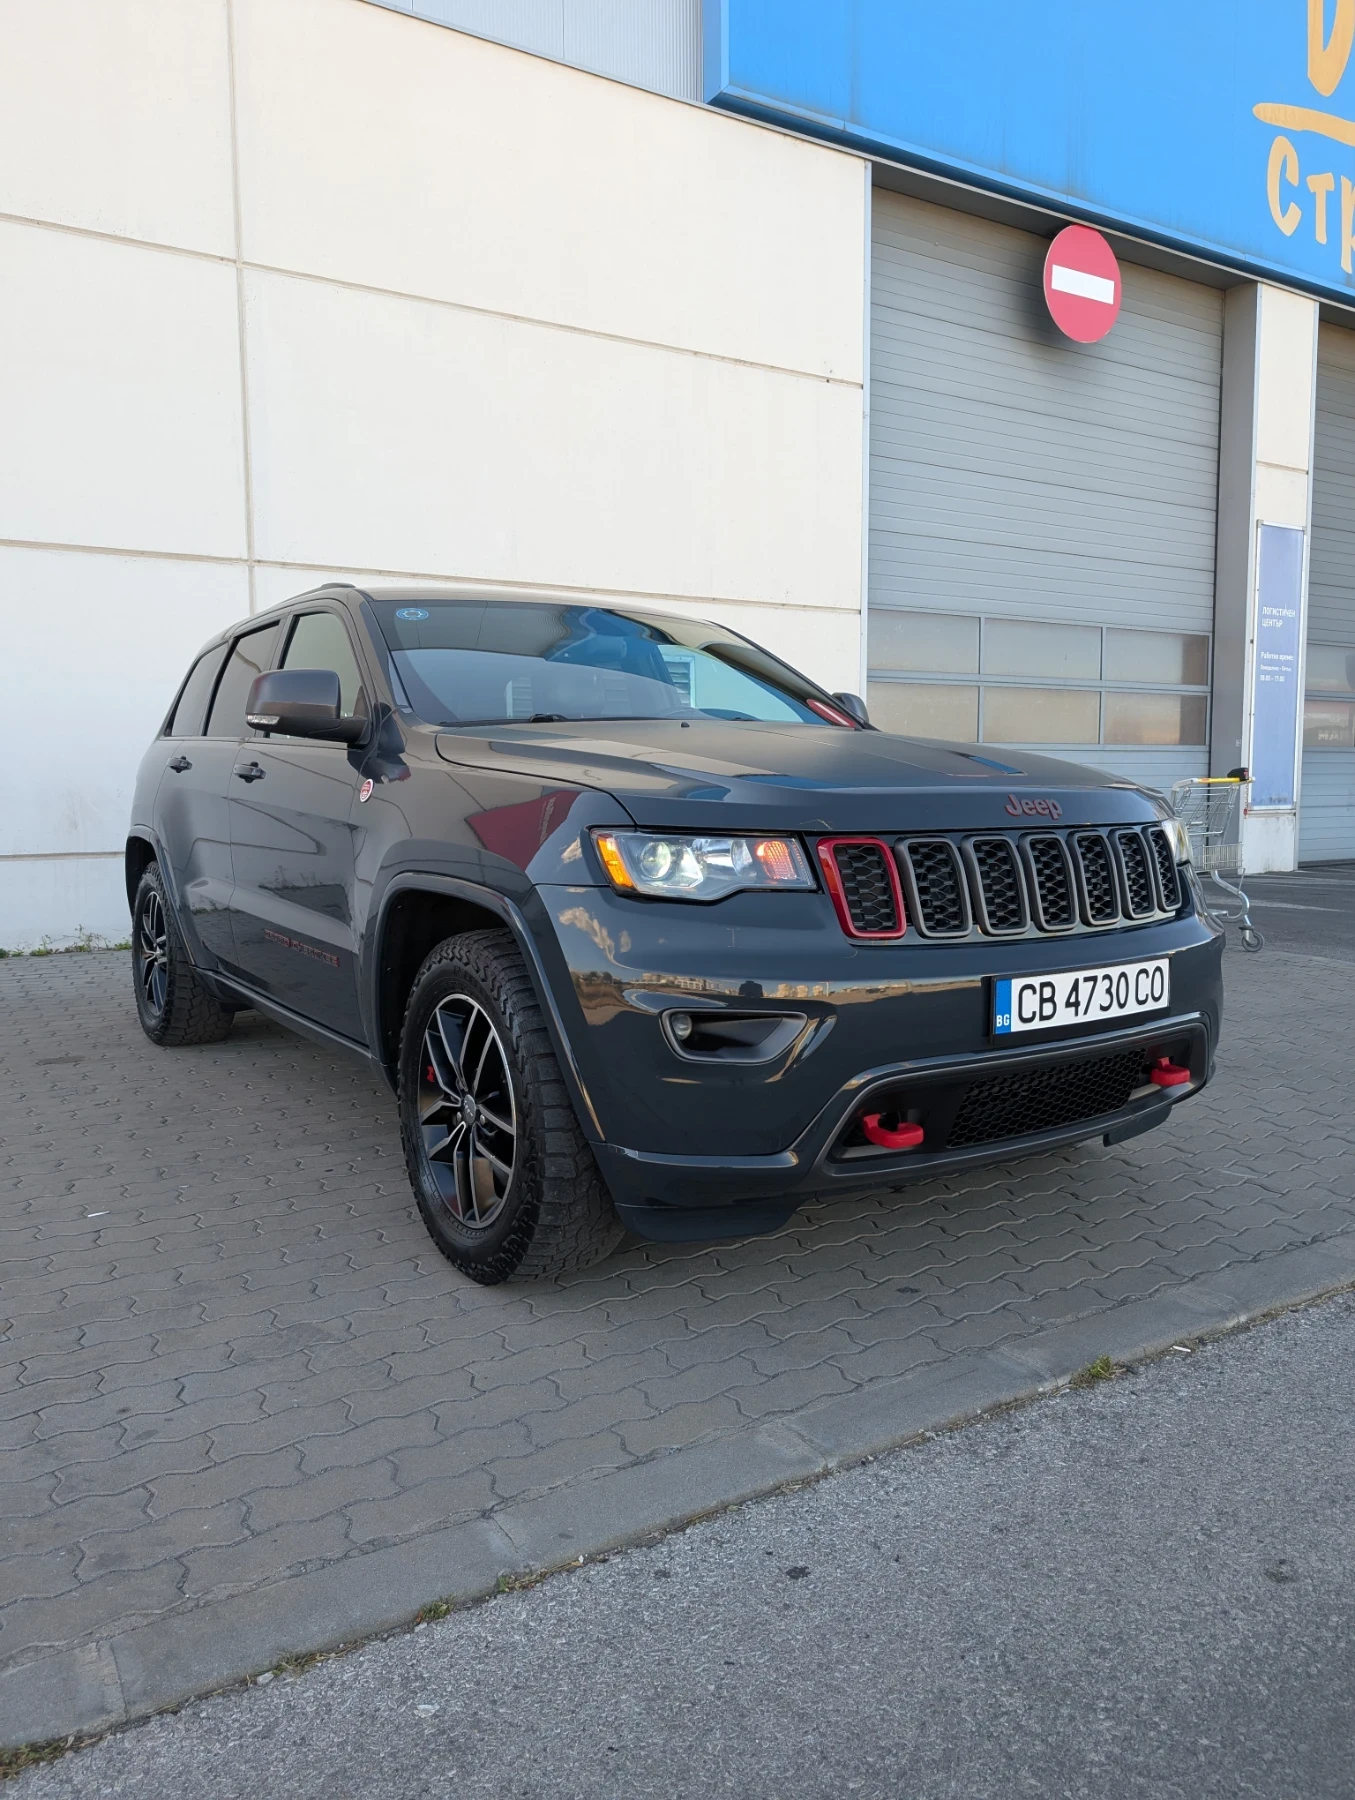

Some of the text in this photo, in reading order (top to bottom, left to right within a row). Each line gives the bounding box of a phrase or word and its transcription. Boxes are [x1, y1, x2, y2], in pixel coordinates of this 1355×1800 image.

[1261, 606, 1296, 618] ЛОГИСТИЧЕН
[1261, 618, 1283, 628] ЦЕНТЪР
[1004, 793, 1063, 820] Jeep
[1018, 965, 1164, 1024] CB 4730 CO
[996, 1014, 1010, 1027] BG
